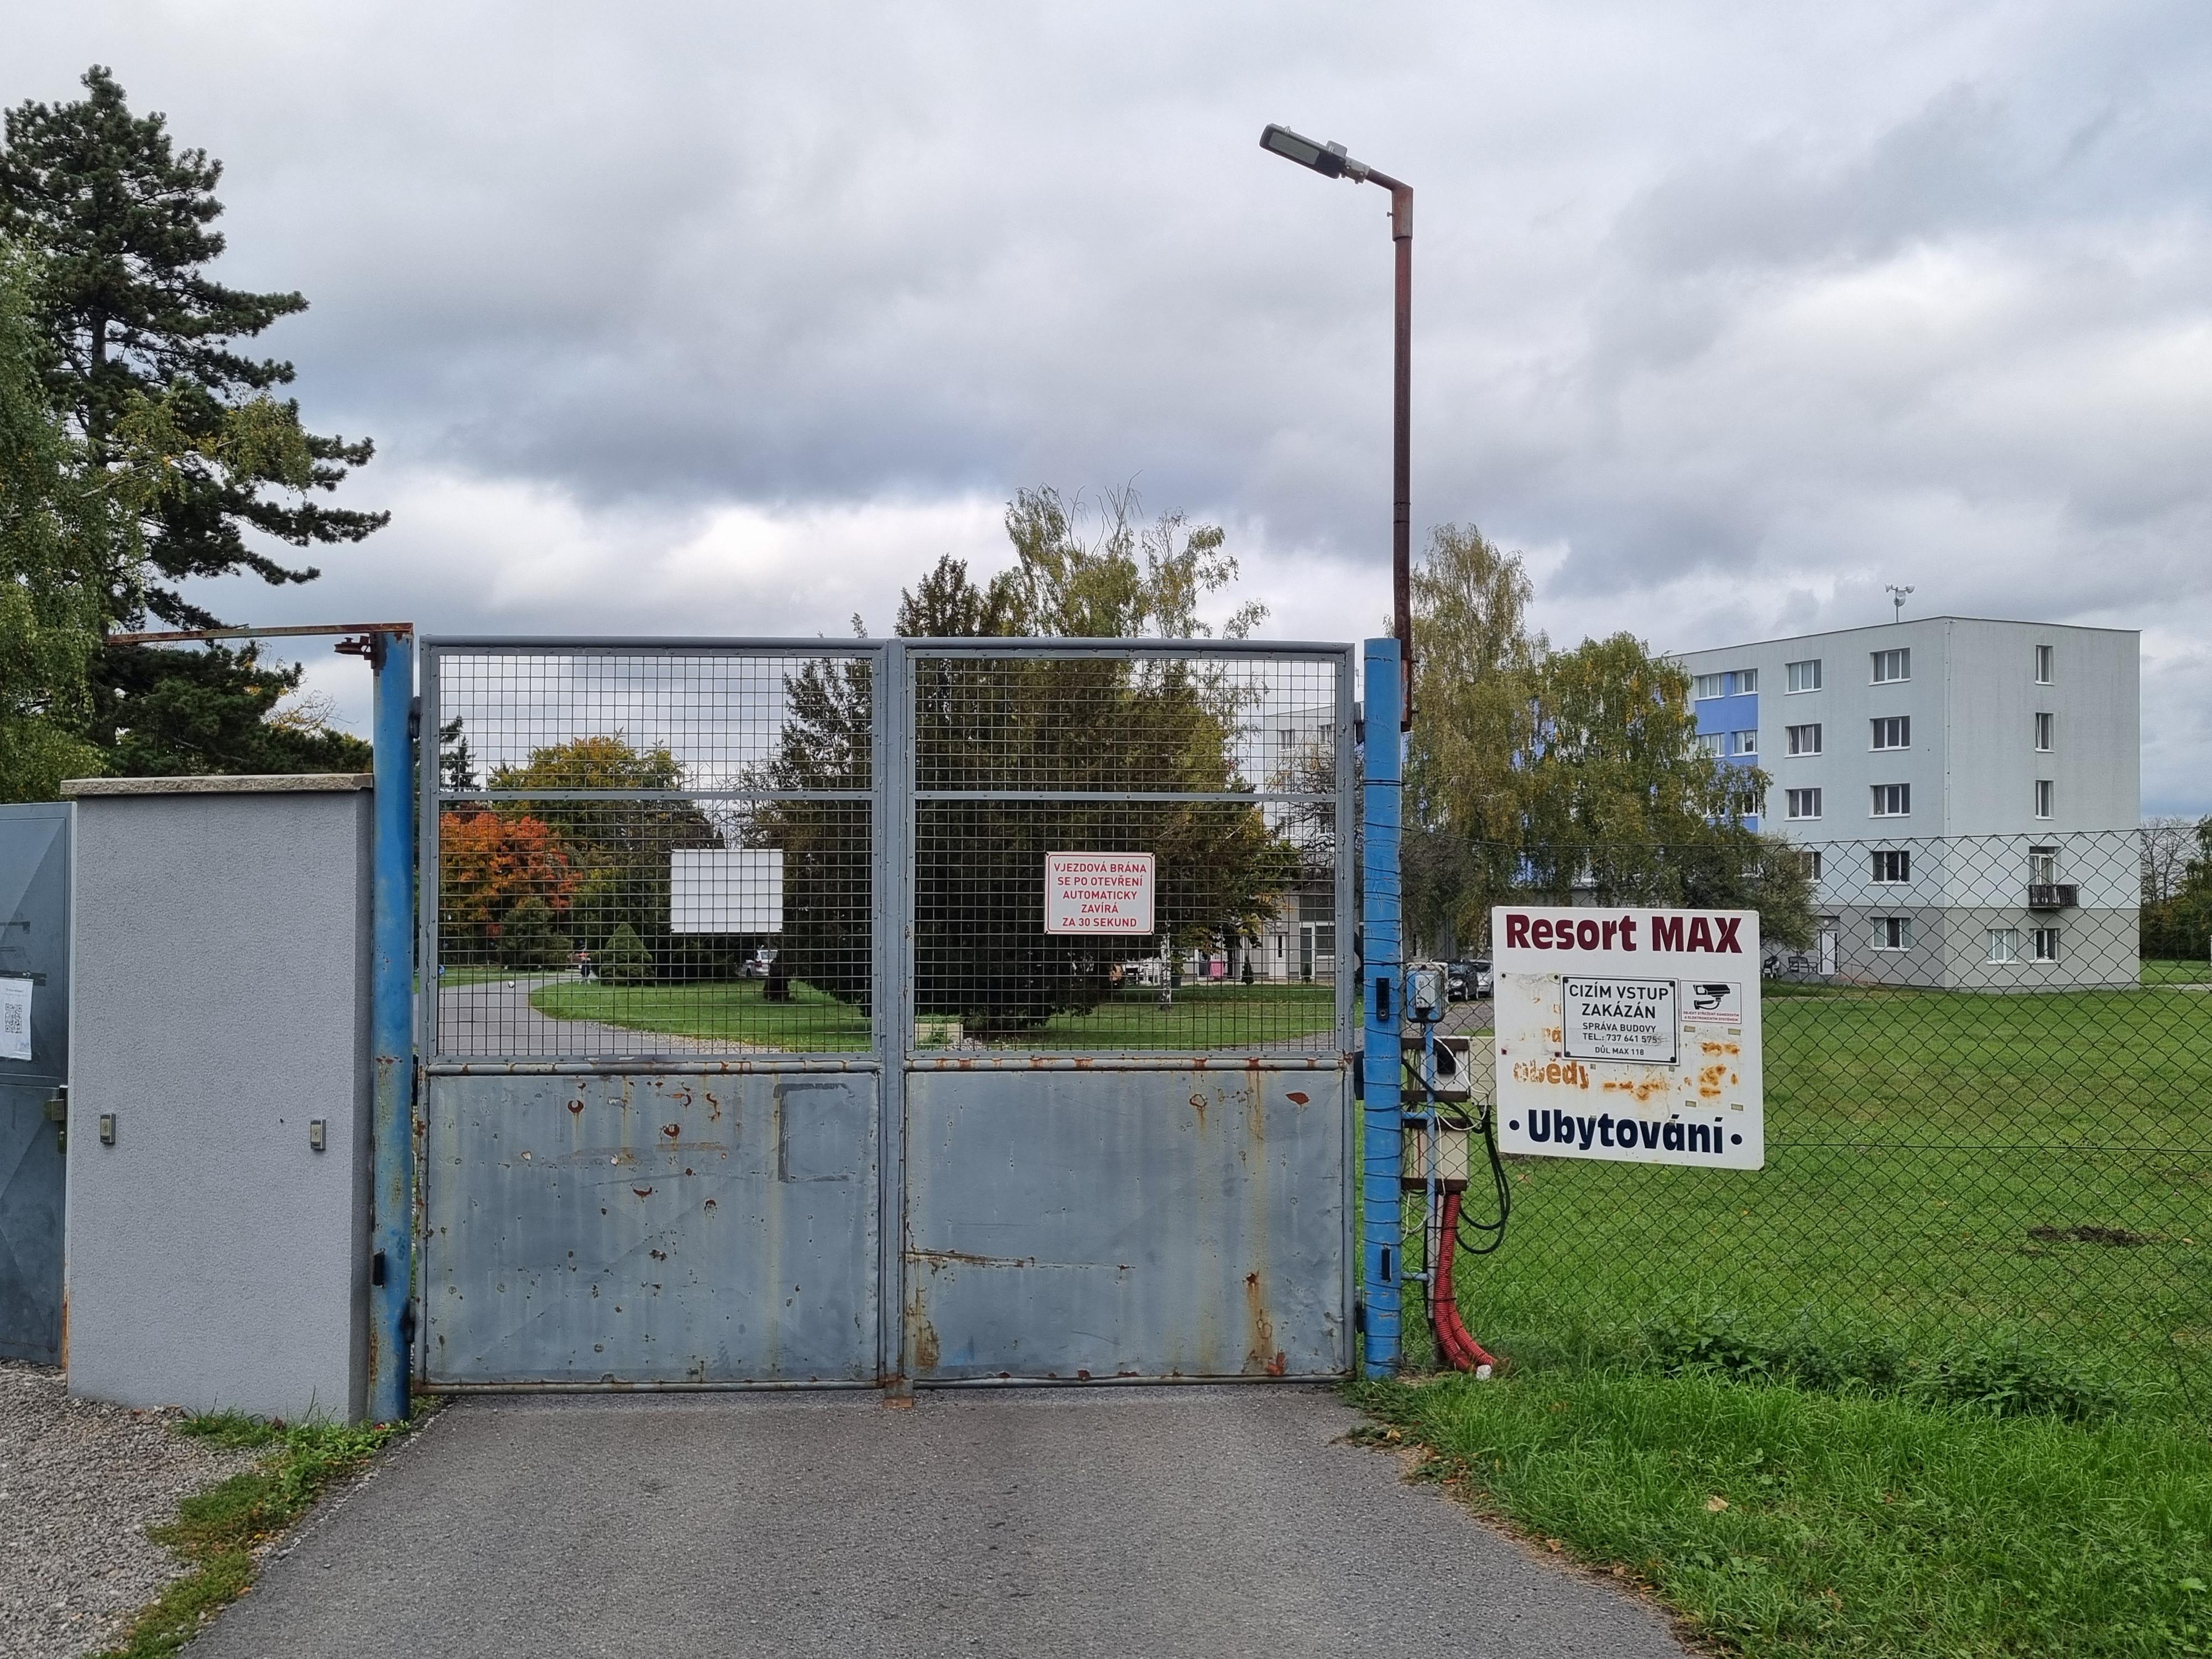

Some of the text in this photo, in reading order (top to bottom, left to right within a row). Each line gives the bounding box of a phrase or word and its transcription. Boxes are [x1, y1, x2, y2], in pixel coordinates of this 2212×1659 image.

[1054, 861, 1146, 873] VJEZDOVÁ BRÁNA
[1057, 875, 1142, 886] SE PO OTEVŘENÍ
[1062, 890, 1138, 900] AUTOMATICKY
[1081, 902, 1119, 913] ZAVÍRÁ
[1062, 917, 1137, 927] ZA 30 SEKUND
[1506, 914, 1743, 954] Resort MAX
[1569, 982, 1669, 1000] CIZÍM VSTUP
[1582, 1001, 1656, 1019] ZAKÁZÁN
[1583, 1021, 1656, 1033] SPRÁVA BUDOVY
[1595, 1045, 1610, 1054] DŮL
[1528, 1109, 1724, 1154] Ubytování
